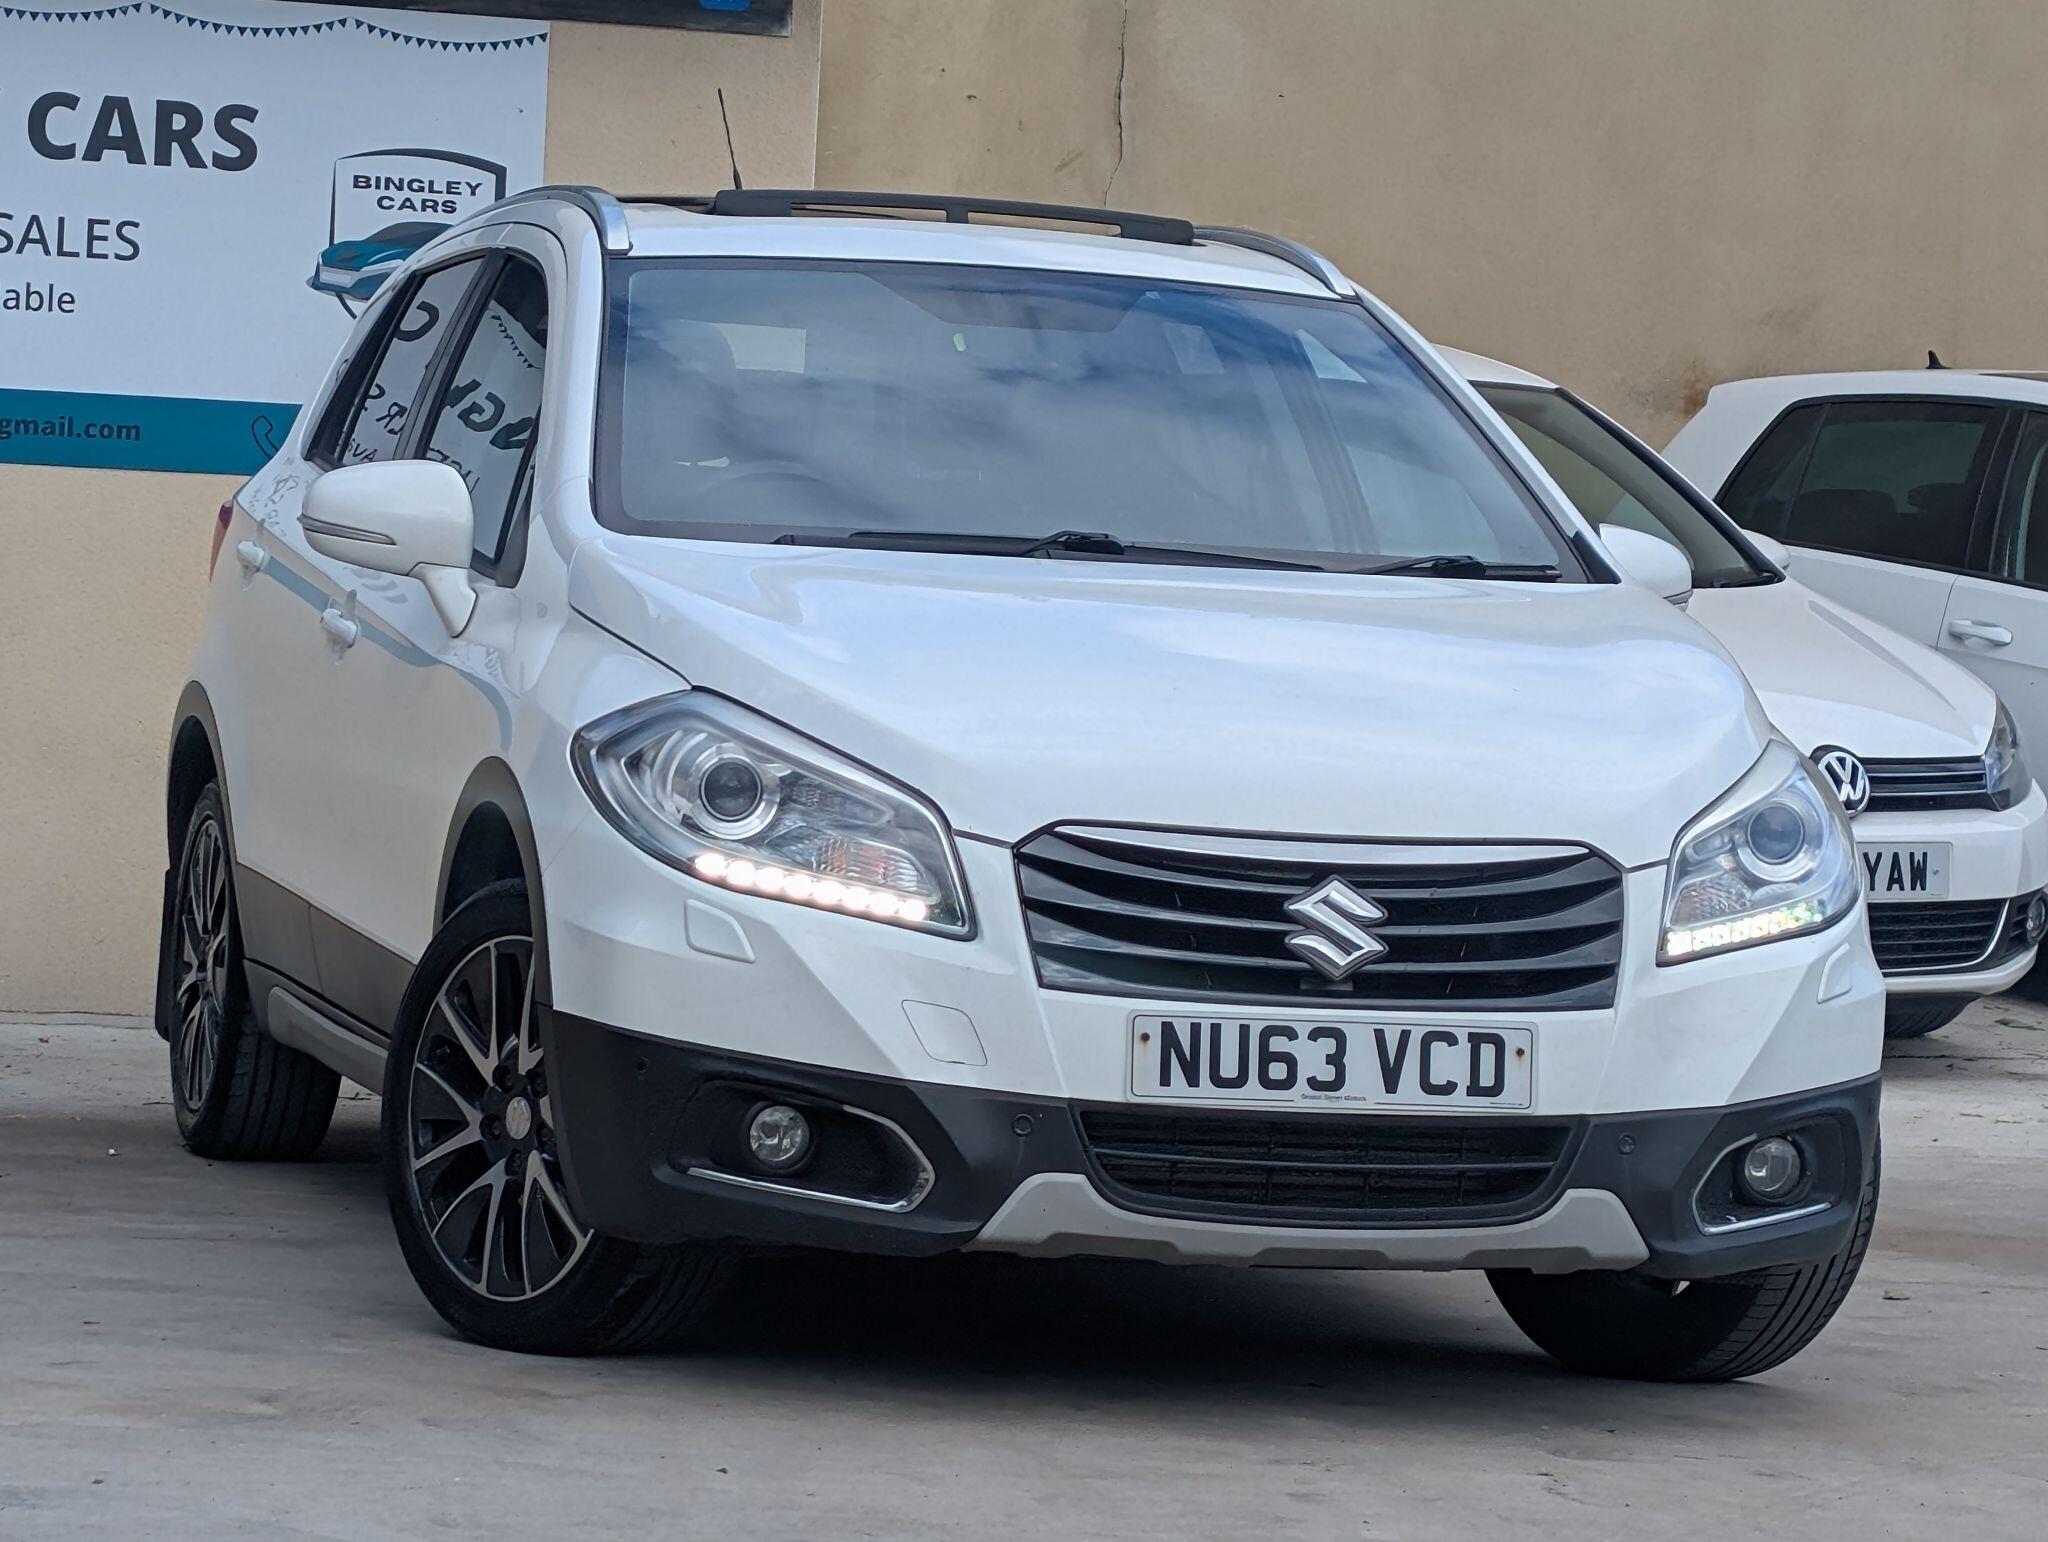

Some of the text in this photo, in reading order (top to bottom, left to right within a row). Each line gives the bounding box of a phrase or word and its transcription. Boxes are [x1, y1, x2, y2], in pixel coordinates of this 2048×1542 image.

[27, 91, 260, 172] CARS
[352, 174, 484, 197] BINGLEY
[376, 195, 458, 215] CARS
[1862, 851, 1928, 892] YAW
[1159, 1020, 1507, 1098] NU63 VCD
